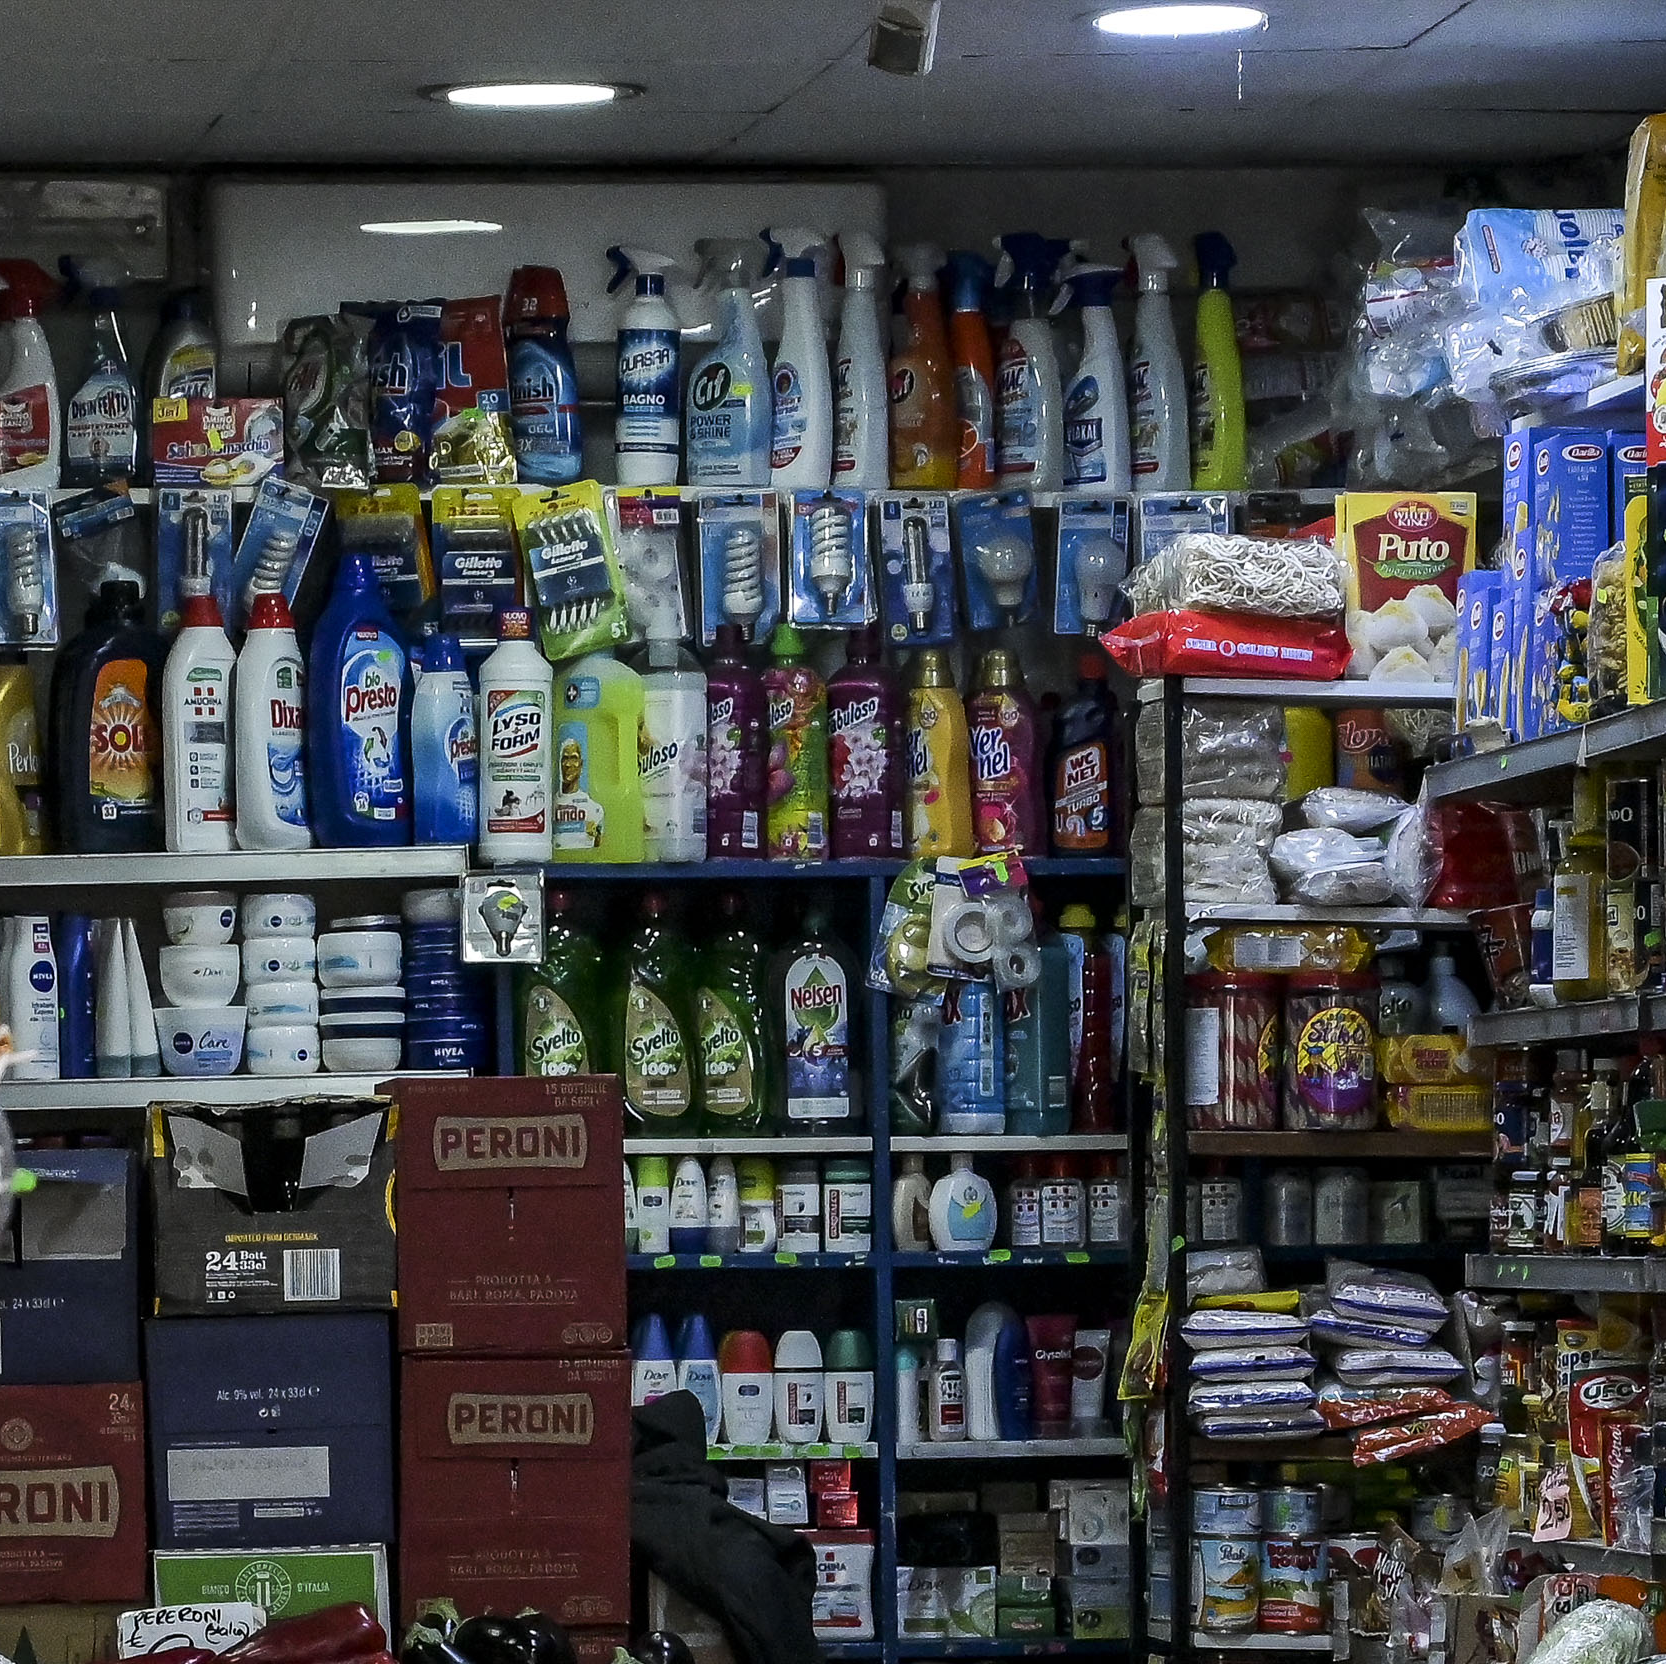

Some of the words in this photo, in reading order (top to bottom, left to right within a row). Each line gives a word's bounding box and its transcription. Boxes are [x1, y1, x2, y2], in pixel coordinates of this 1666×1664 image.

[694, 366, 726, 408] Cif
[623, 393, 666, 405] BAGNO
[689, 413, 732, 427] POWER
[697, 425, 731, 439] SHINE
[1390, 508, 1435, 522] WHITE
[1398, 516, 1430, 529] KING
[540, 539, 591, 561] Gillette
[1377, 533, 1451, 563] Puto
[454, 556, 504, 571] Gillette
[502, 611, 528, 622] NUOVO
[364, 671, 381, 687] bio
[183, 696, 223, 706] AMUCHINA
[493, 712, 542, 737] LYSO
[491, 726, 542, 752] FORM
[969, 725, 1003, 757] Ver
[978, 745, 1011, 780] nel
[1069, 753, 1095, 770] WC
[1065, 765, 1099, 786] NET
[1091, 807, 1104, 825] 5
[31, 971, 54, 981] NIVEA
[789, 982, 843, 1011] Nelsen
[198, 1030, 231, 1051] Care
[531, 1026, 583, 1064] Svelto
[631, 1026, 681, 1065] Svelto
[433, 1047, 465, 1058] NIVEA
[640, 1062, 678, 1076] 100%
[439, 1125, 582, 1160] PERONI
[205, 1250, 239, 1272] 24
[238, 1260, 267, 1271] 33cl
[643, 1369, 670, 1382] Dove
[687, 1370, 714, 1384] Dove
[268, 1387, 280, 1399] 24
[453, 1402, 588, 1435] PERONI
